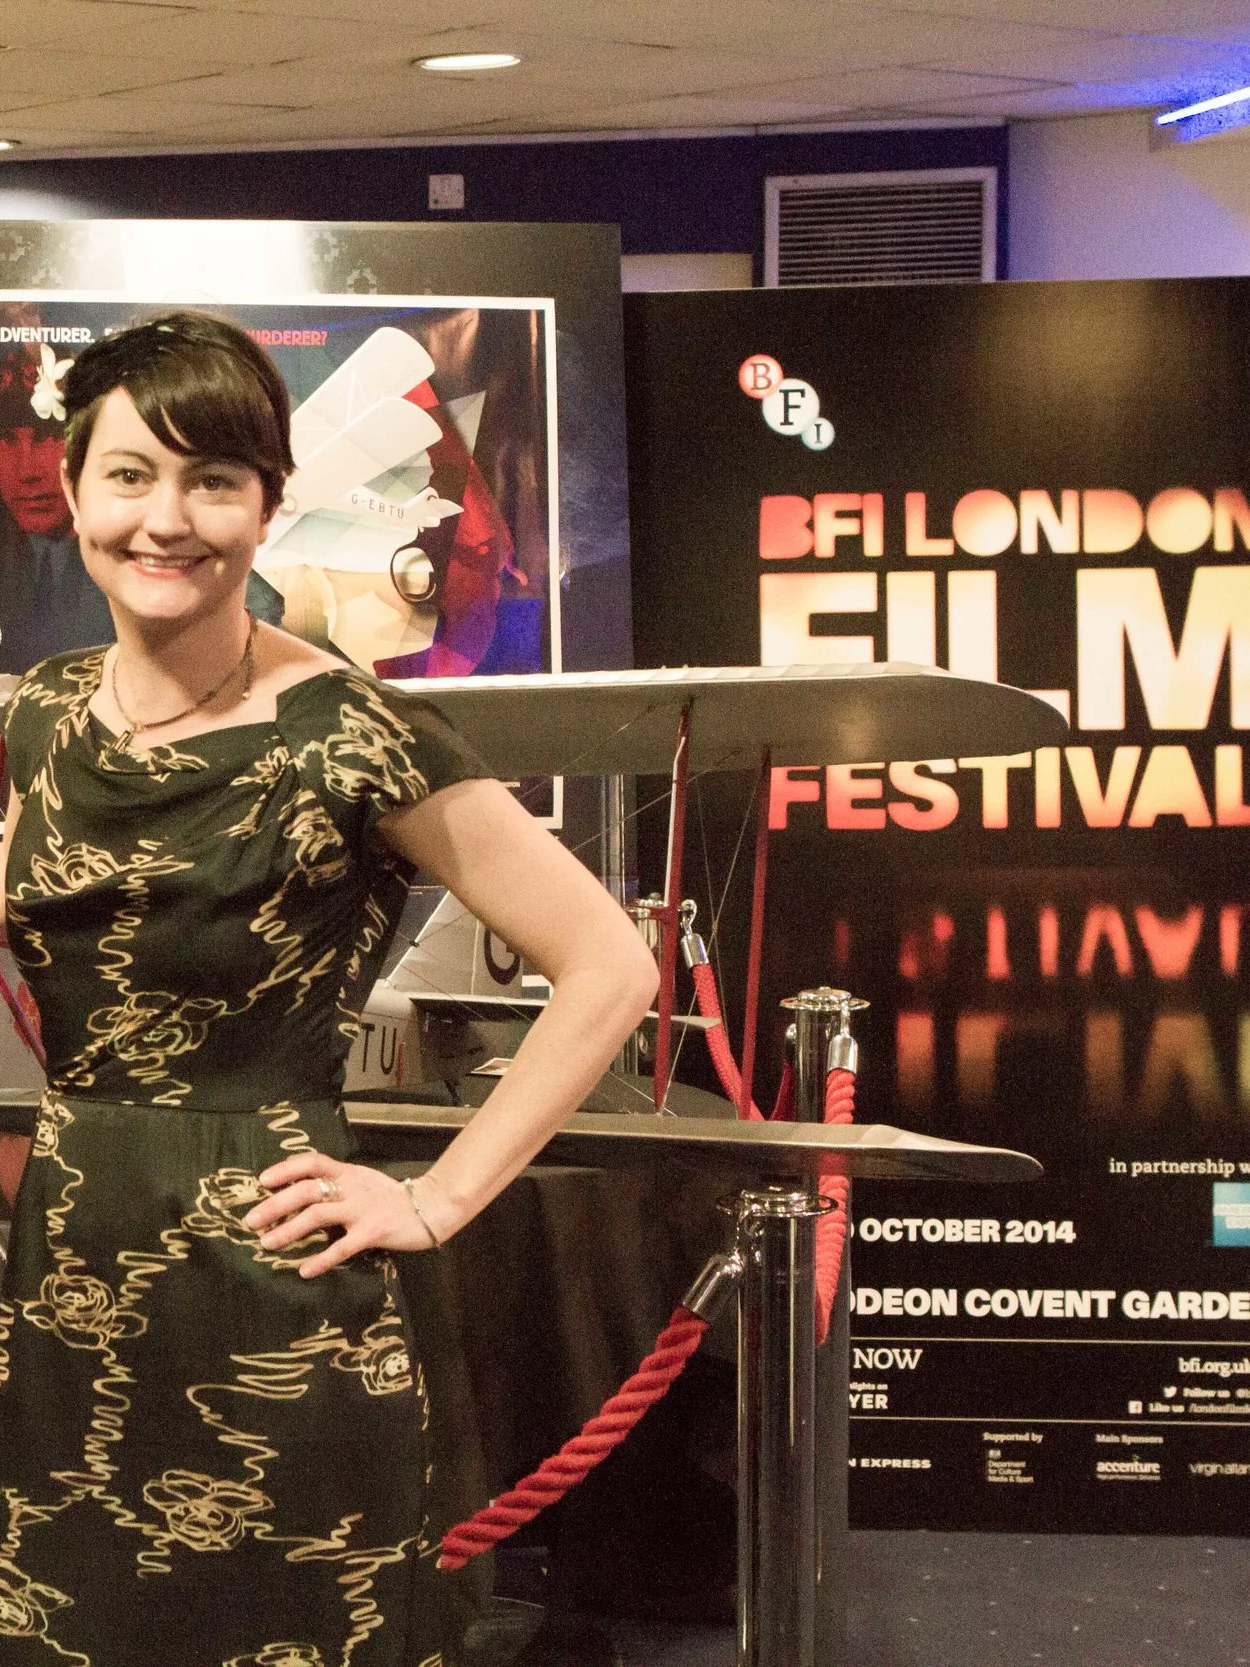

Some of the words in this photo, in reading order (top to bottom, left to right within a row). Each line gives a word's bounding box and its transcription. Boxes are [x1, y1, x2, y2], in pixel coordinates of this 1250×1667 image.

[247, 329, 328, 346] URDERER?
[351, 493, 404, 519] G-EBTU
[759, 493, 884, 559] BFI
[905, 488, 1250, 556] LONDON
[759, 565, 1250, 730] FILM
[768, 746, 1250, 831] FESTIVAL
[1110, 1158, 1127, 1173] in
[1132, 1159, 1236, 1178] partnership
[859, 1218, 1001, 1242] OCTOBER
[1005, 1220, 1076, 1243] 2014
[850, 1288, 957, 1316] DEON
[964, 1289, 1116, 1318] COVENT
[853, 1348, 923, 1369] NOW
[982, 1432, 1029, 1442] Supported
[1031, 1433, 1043, 1443] by
[860, 1459, 931, 1468] EXPRESS
